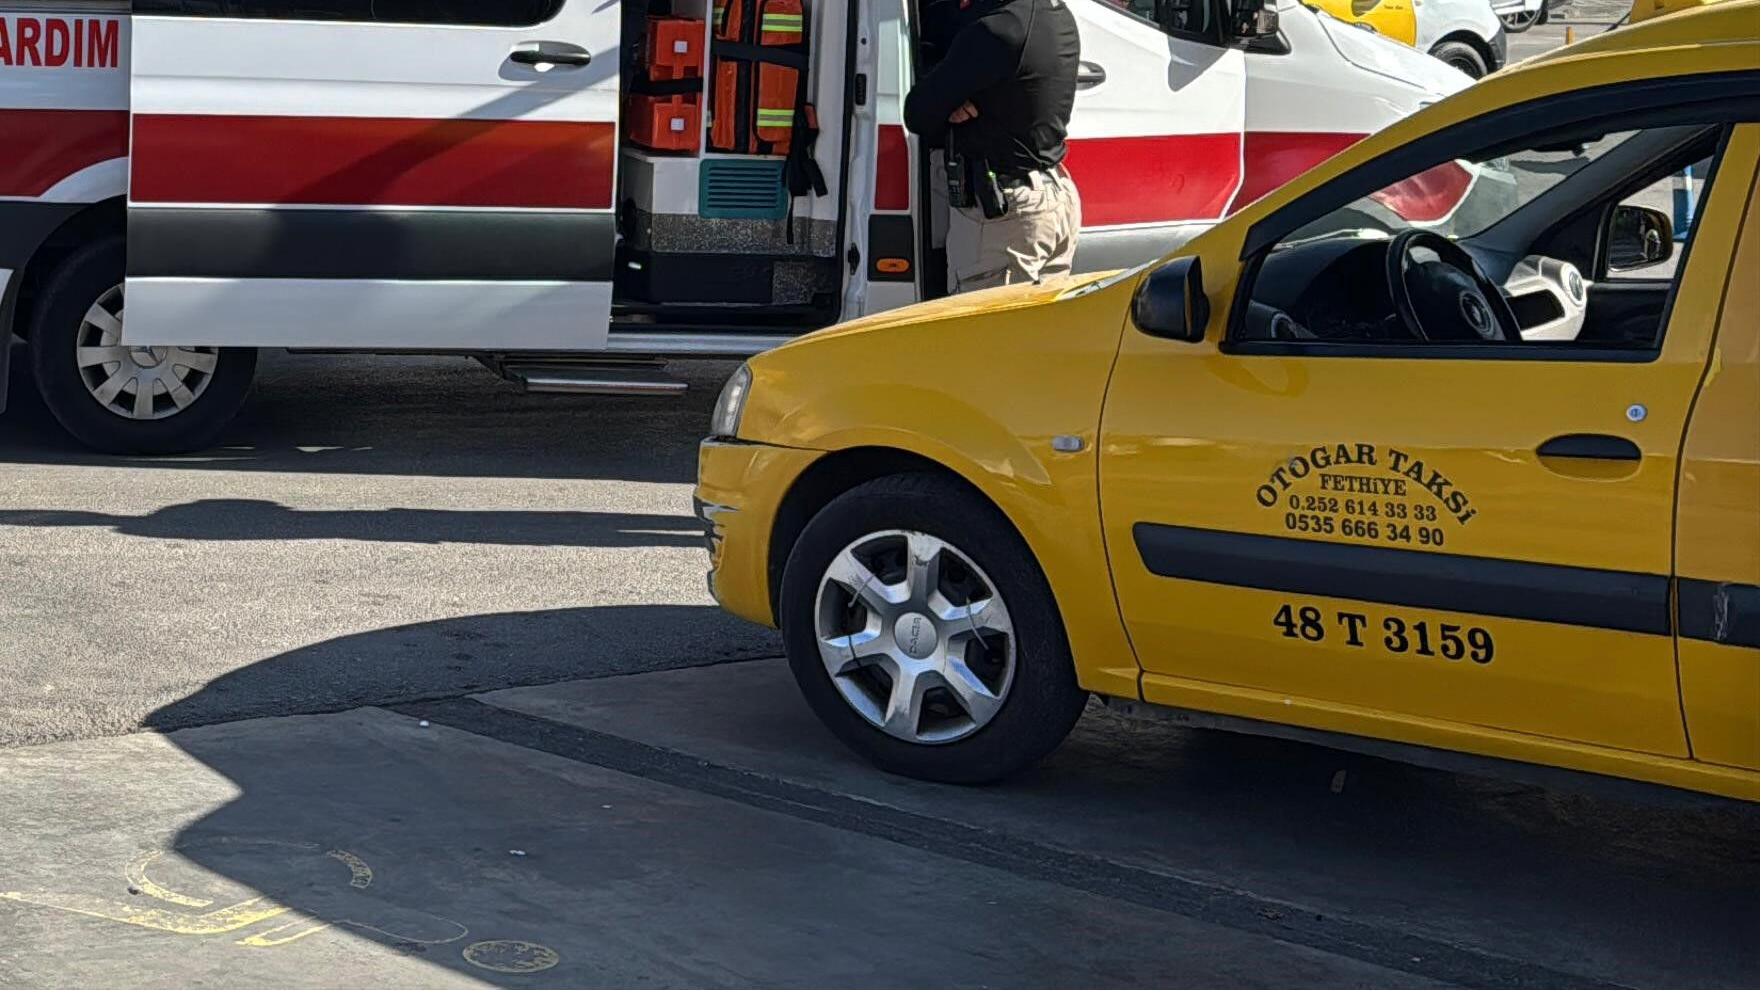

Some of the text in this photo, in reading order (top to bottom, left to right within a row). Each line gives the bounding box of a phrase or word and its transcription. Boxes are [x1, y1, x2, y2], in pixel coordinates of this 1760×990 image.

[1256, 443, 1378, 508] OTOGAR
[1285, 512, 1445, 546] 0535 666 34 90
[1345, 498, 1379, 516] 614
[1385, 502, 1408, 520] 33
[1414, 504, 1438, 522] 33
[1273, 604, 1495, 664] 48 T 3159
